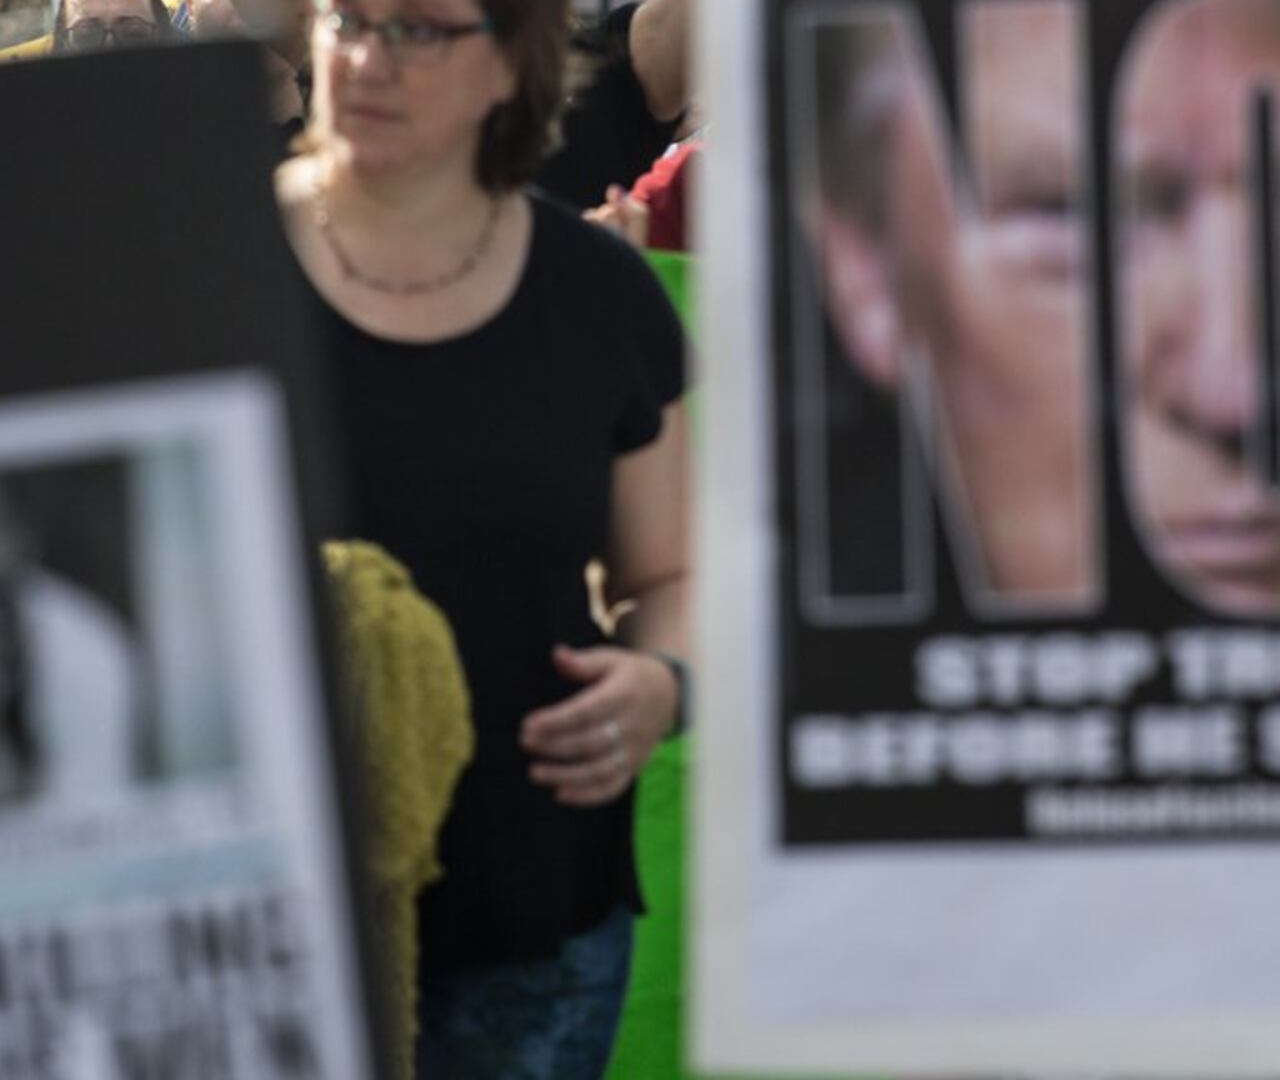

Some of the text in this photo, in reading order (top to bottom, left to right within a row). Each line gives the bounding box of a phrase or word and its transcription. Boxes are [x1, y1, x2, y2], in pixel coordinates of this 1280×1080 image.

[917, 630, 1153, 707] STOP
[790, 714, 1119, 788] BEFORE
[1129, 706, 1245, 777] HE
